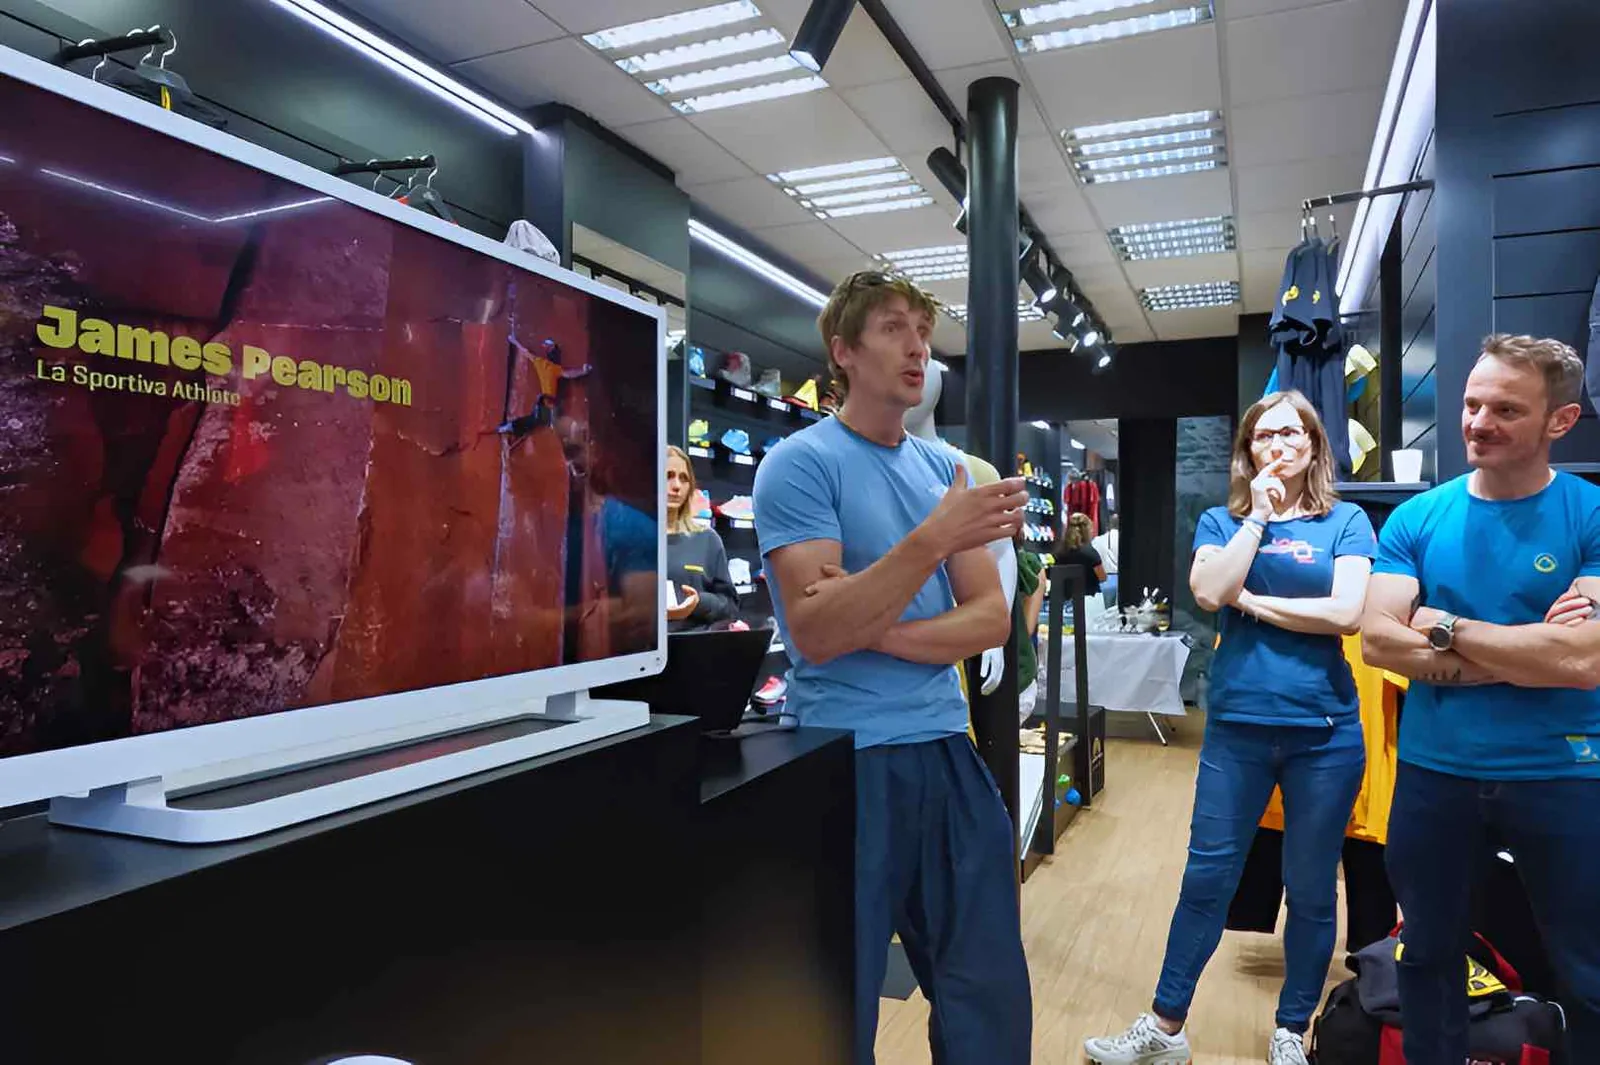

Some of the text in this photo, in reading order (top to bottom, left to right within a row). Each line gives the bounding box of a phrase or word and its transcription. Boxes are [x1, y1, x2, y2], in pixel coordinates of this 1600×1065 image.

[36, 304, 412, 407] James Pearson
[37, 358, 66, 382] La
[73, 364, 167, 396] Sportiva
